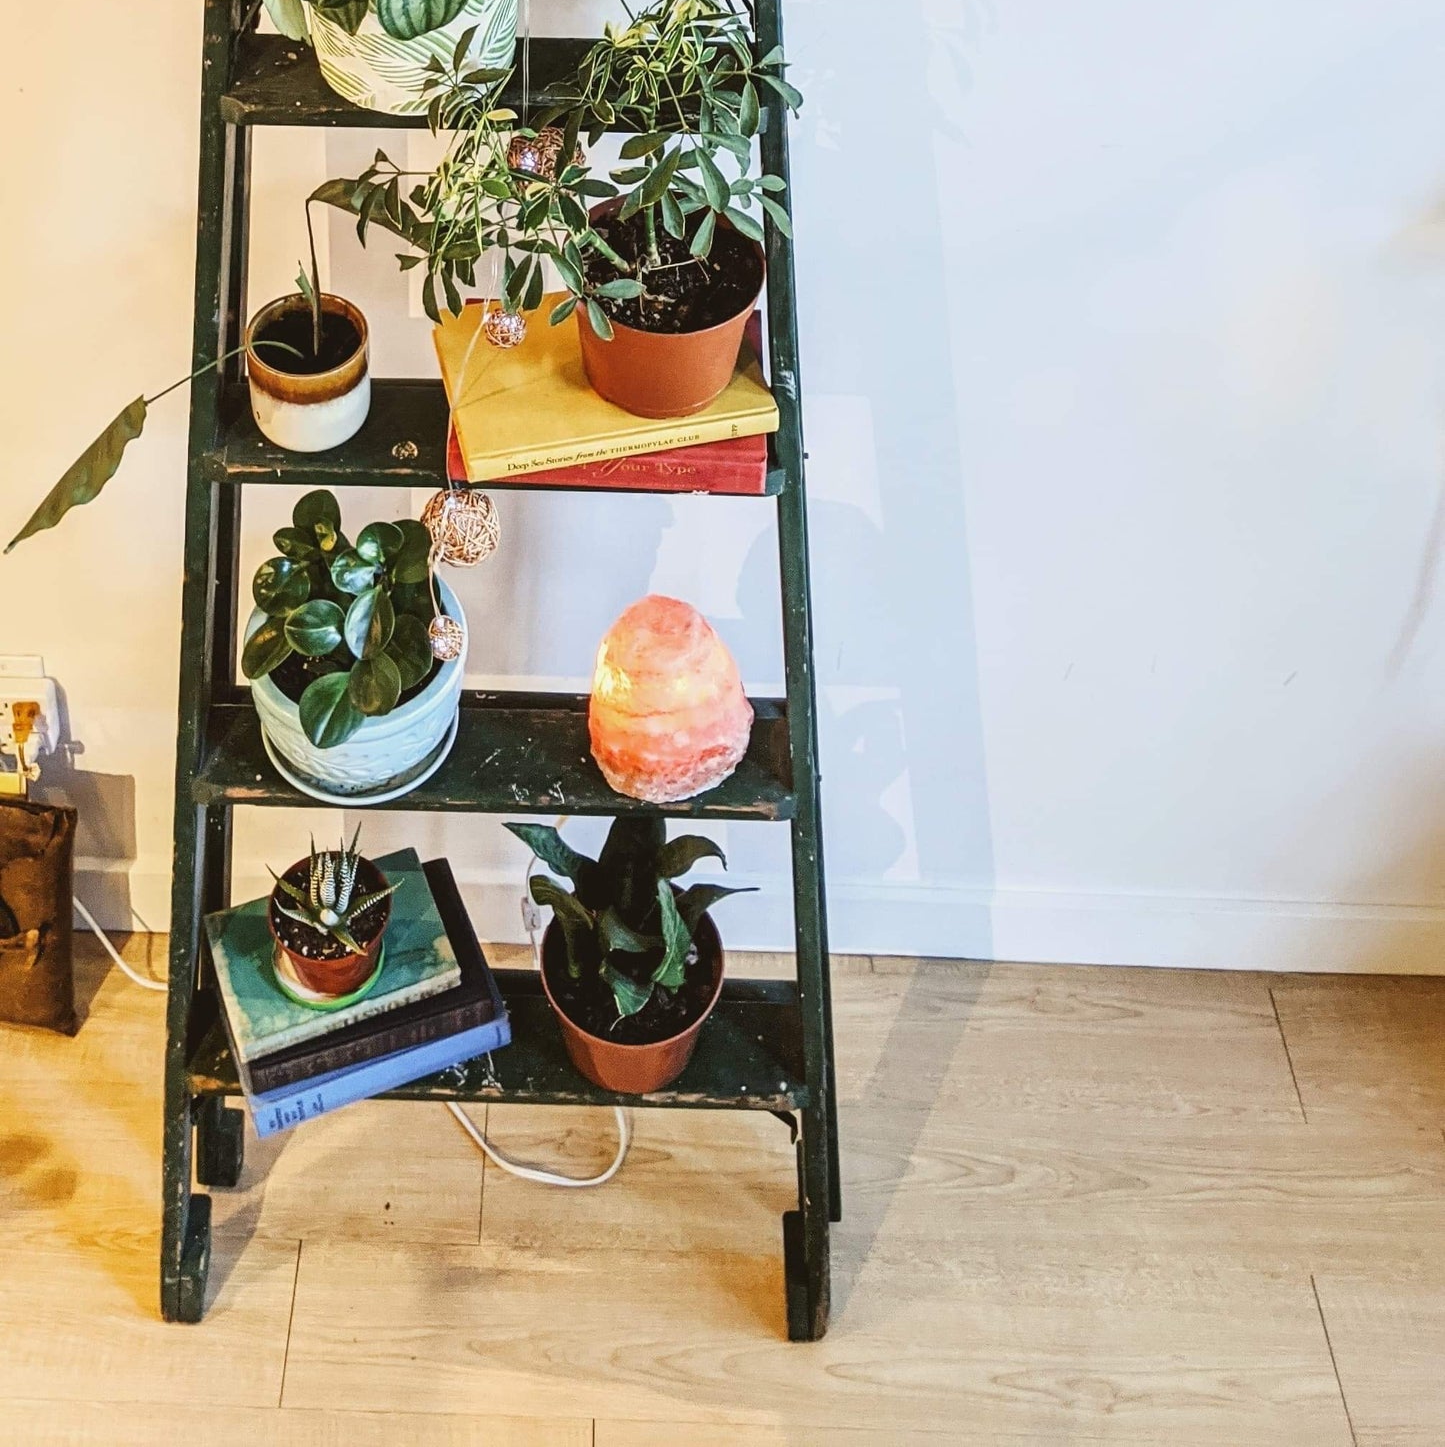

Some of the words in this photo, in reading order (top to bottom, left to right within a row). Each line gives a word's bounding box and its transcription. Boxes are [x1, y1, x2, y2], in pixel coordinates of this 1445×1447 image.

[507, 462, 529, 471] Deep
[531, 458, 545, 467] Sea
[545, 456, 573, 465] Stories
[575, 451, 594, 461] from
[610, 438, 674, 454] THERMOPYLAE
[677, 434, 700, 443] CLUB
[655, 462, 696, 475] Type
